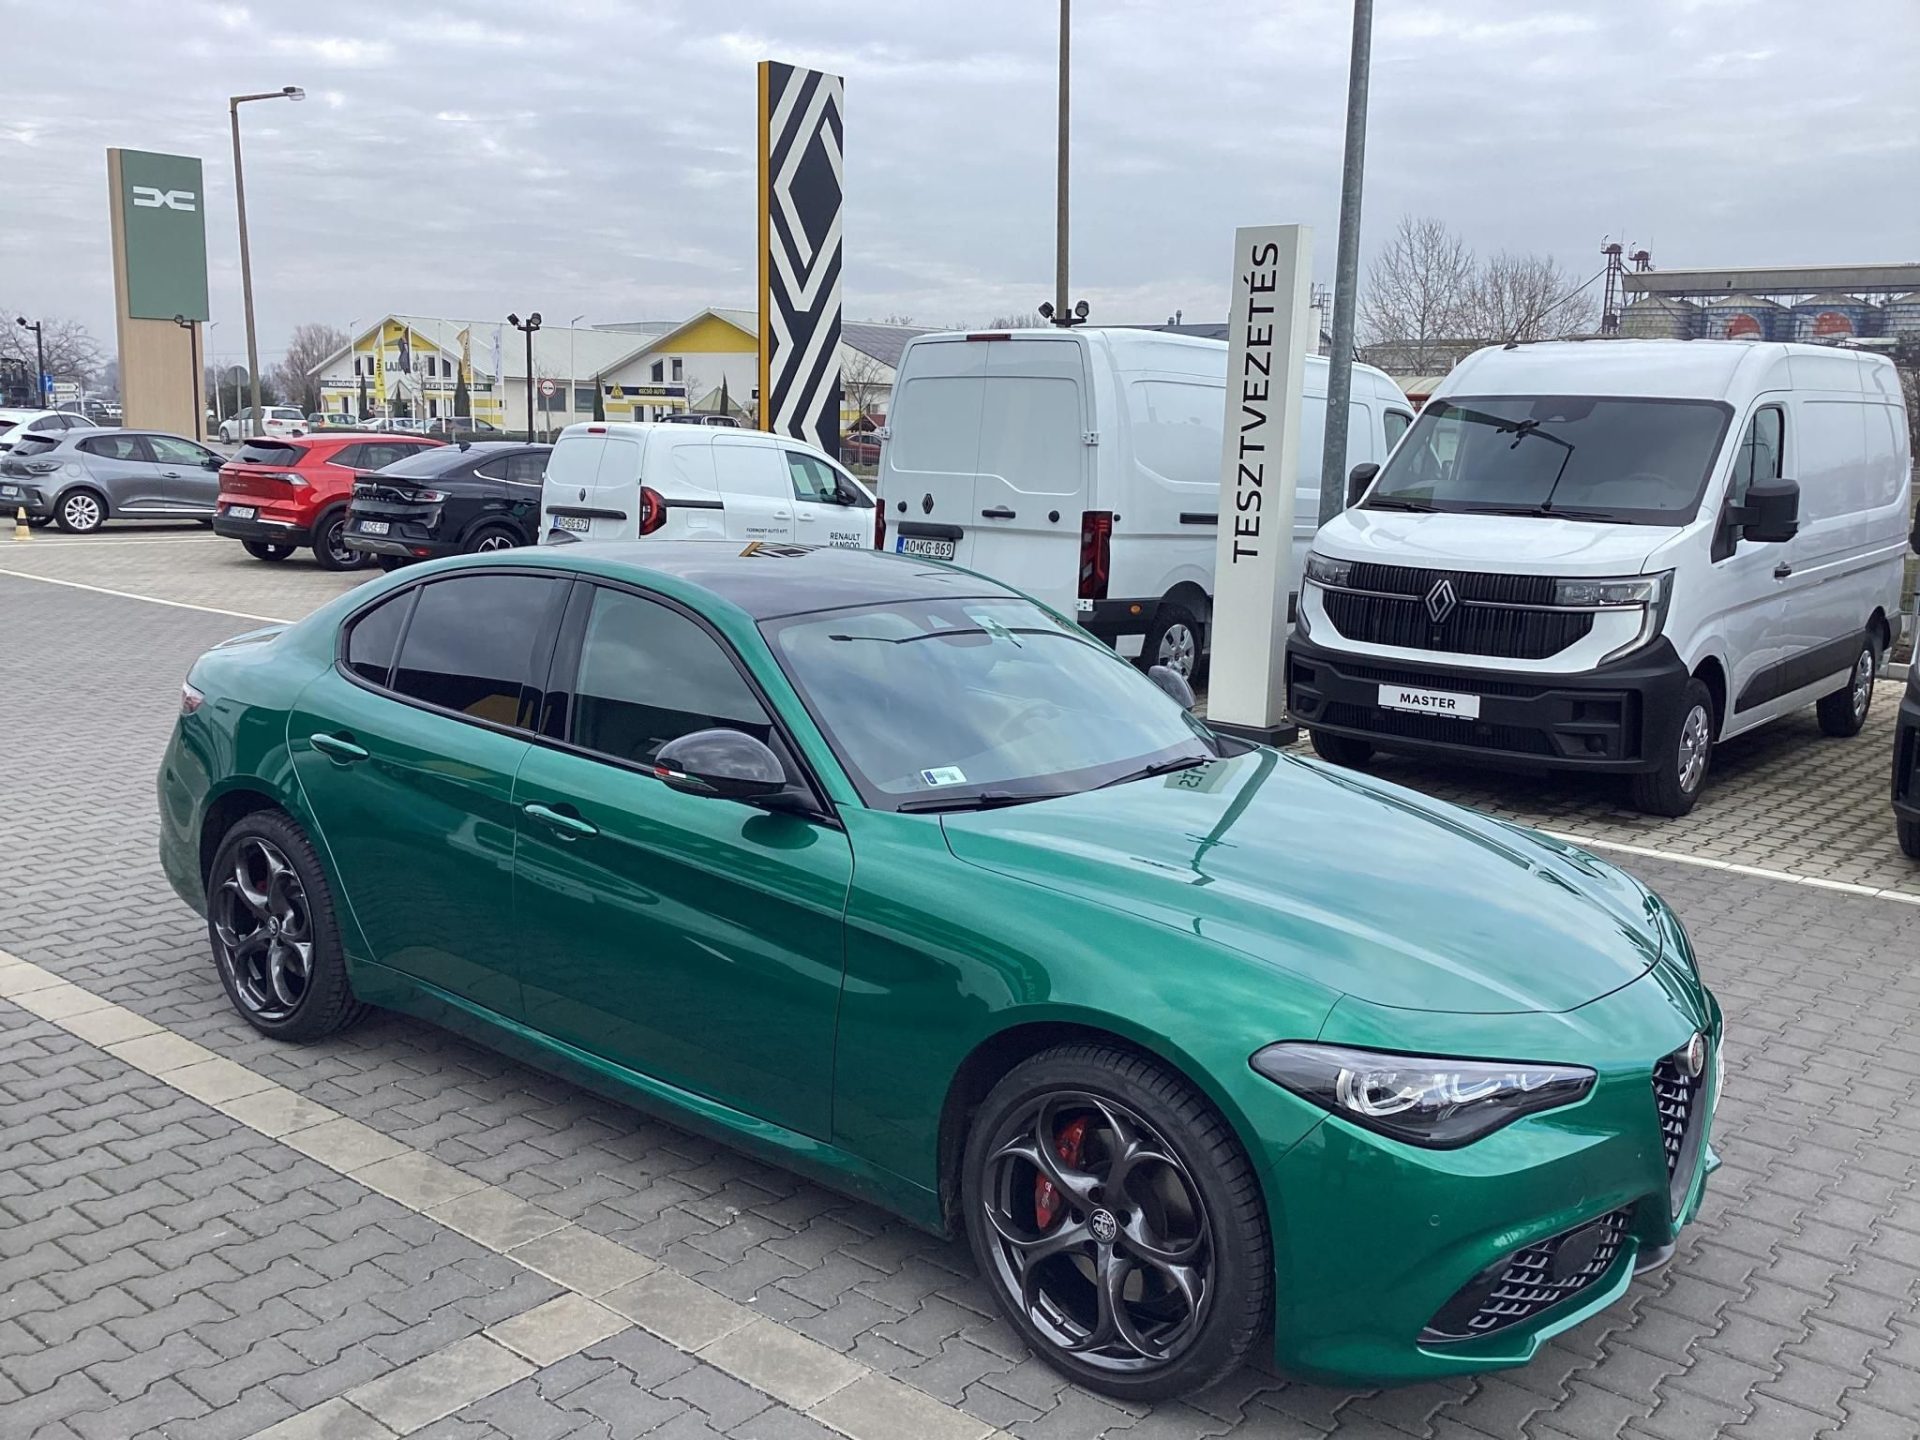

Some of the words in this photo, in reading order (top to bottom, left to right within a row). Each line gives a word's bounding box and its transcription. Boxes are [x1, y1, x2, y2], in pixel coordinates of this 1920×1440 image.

[1233, 242, 1279, 564] TESZTVEZETÉS
[829, 532, 861, 541] RENAULT
[1400, 693, 1456, 709] MASTER
